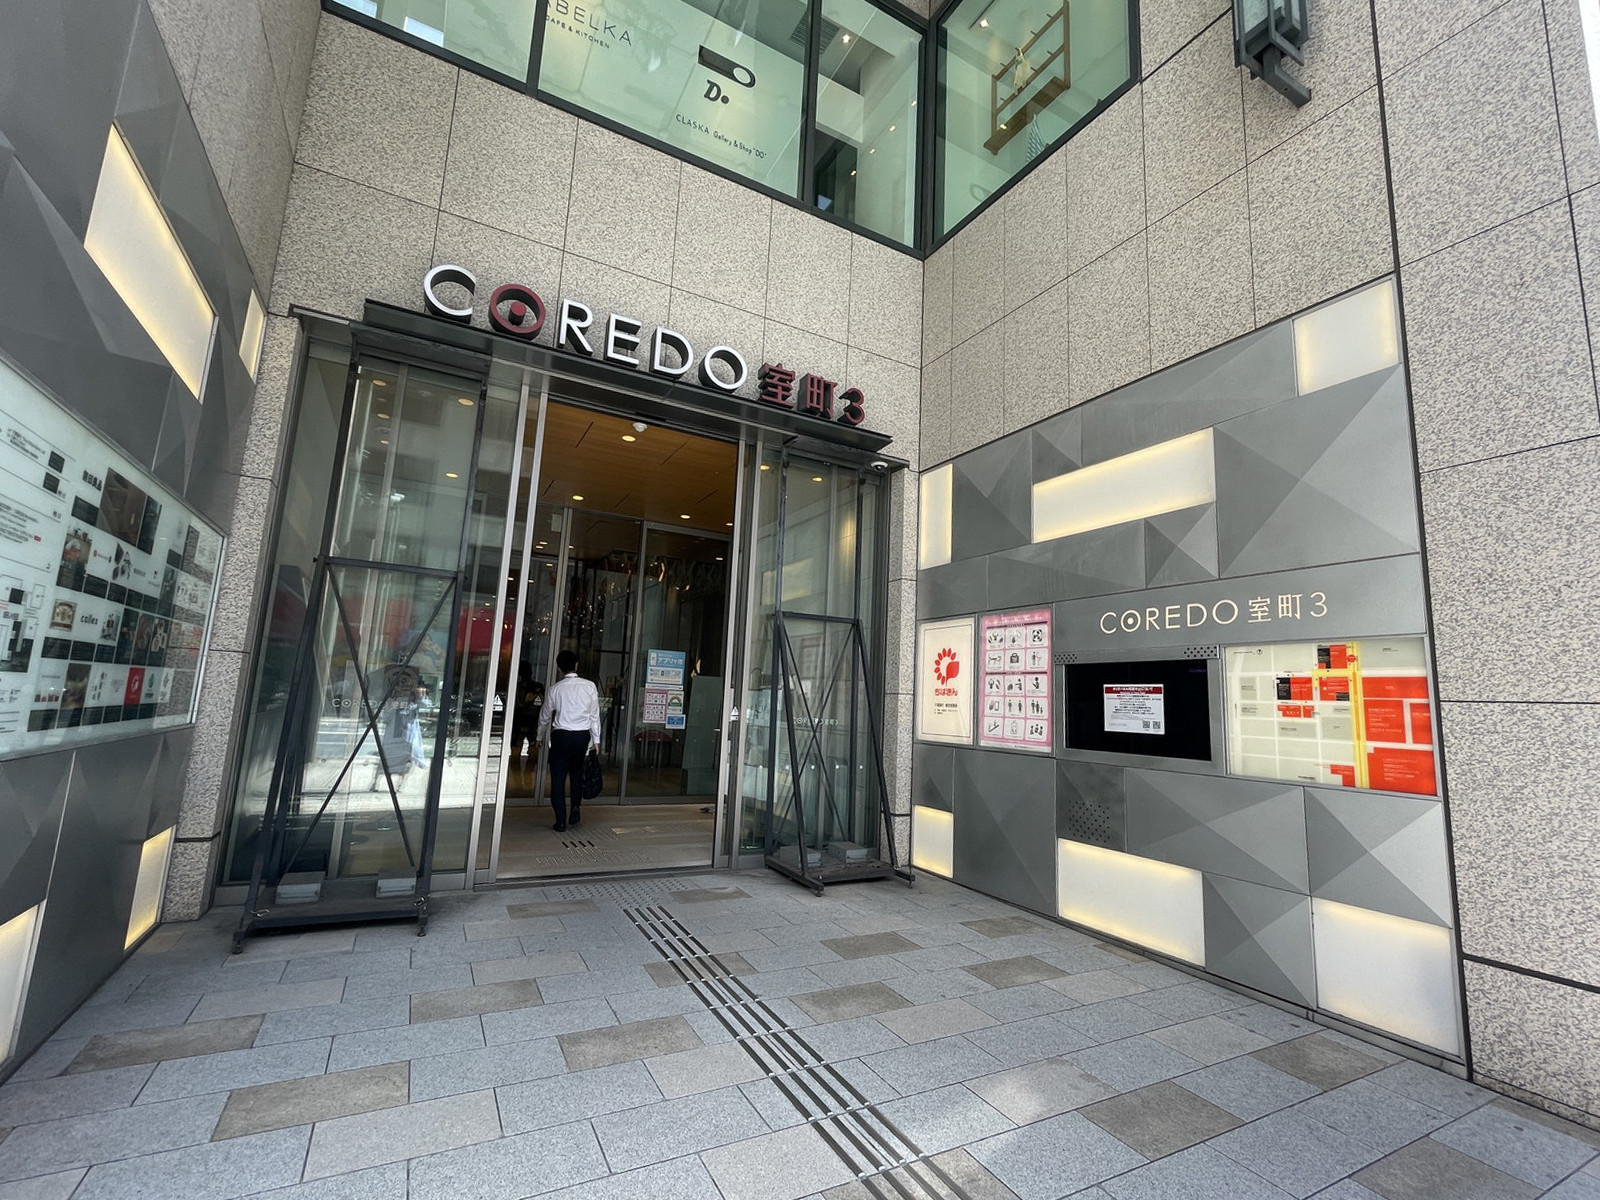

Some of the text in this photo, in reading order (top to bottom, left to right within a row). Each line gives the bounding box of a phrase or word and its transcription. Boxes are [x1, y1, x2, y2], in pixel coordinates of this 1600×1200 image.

[547, 0, 631, 46] BELKA
[576, 30, 610, 49] KITCHEN
[675, 113, 710, 135] CLASKA
[713, 130, 732, 146] Gallery
[733, 140, 739, 148] &
[739, 142, 753, 155] Shop
[422, 263, 866, 426] COREDO 室町3
[1099, 591, 1329, 635] COREDO 室町3
[934, 688, 958, 697] ちばきん
